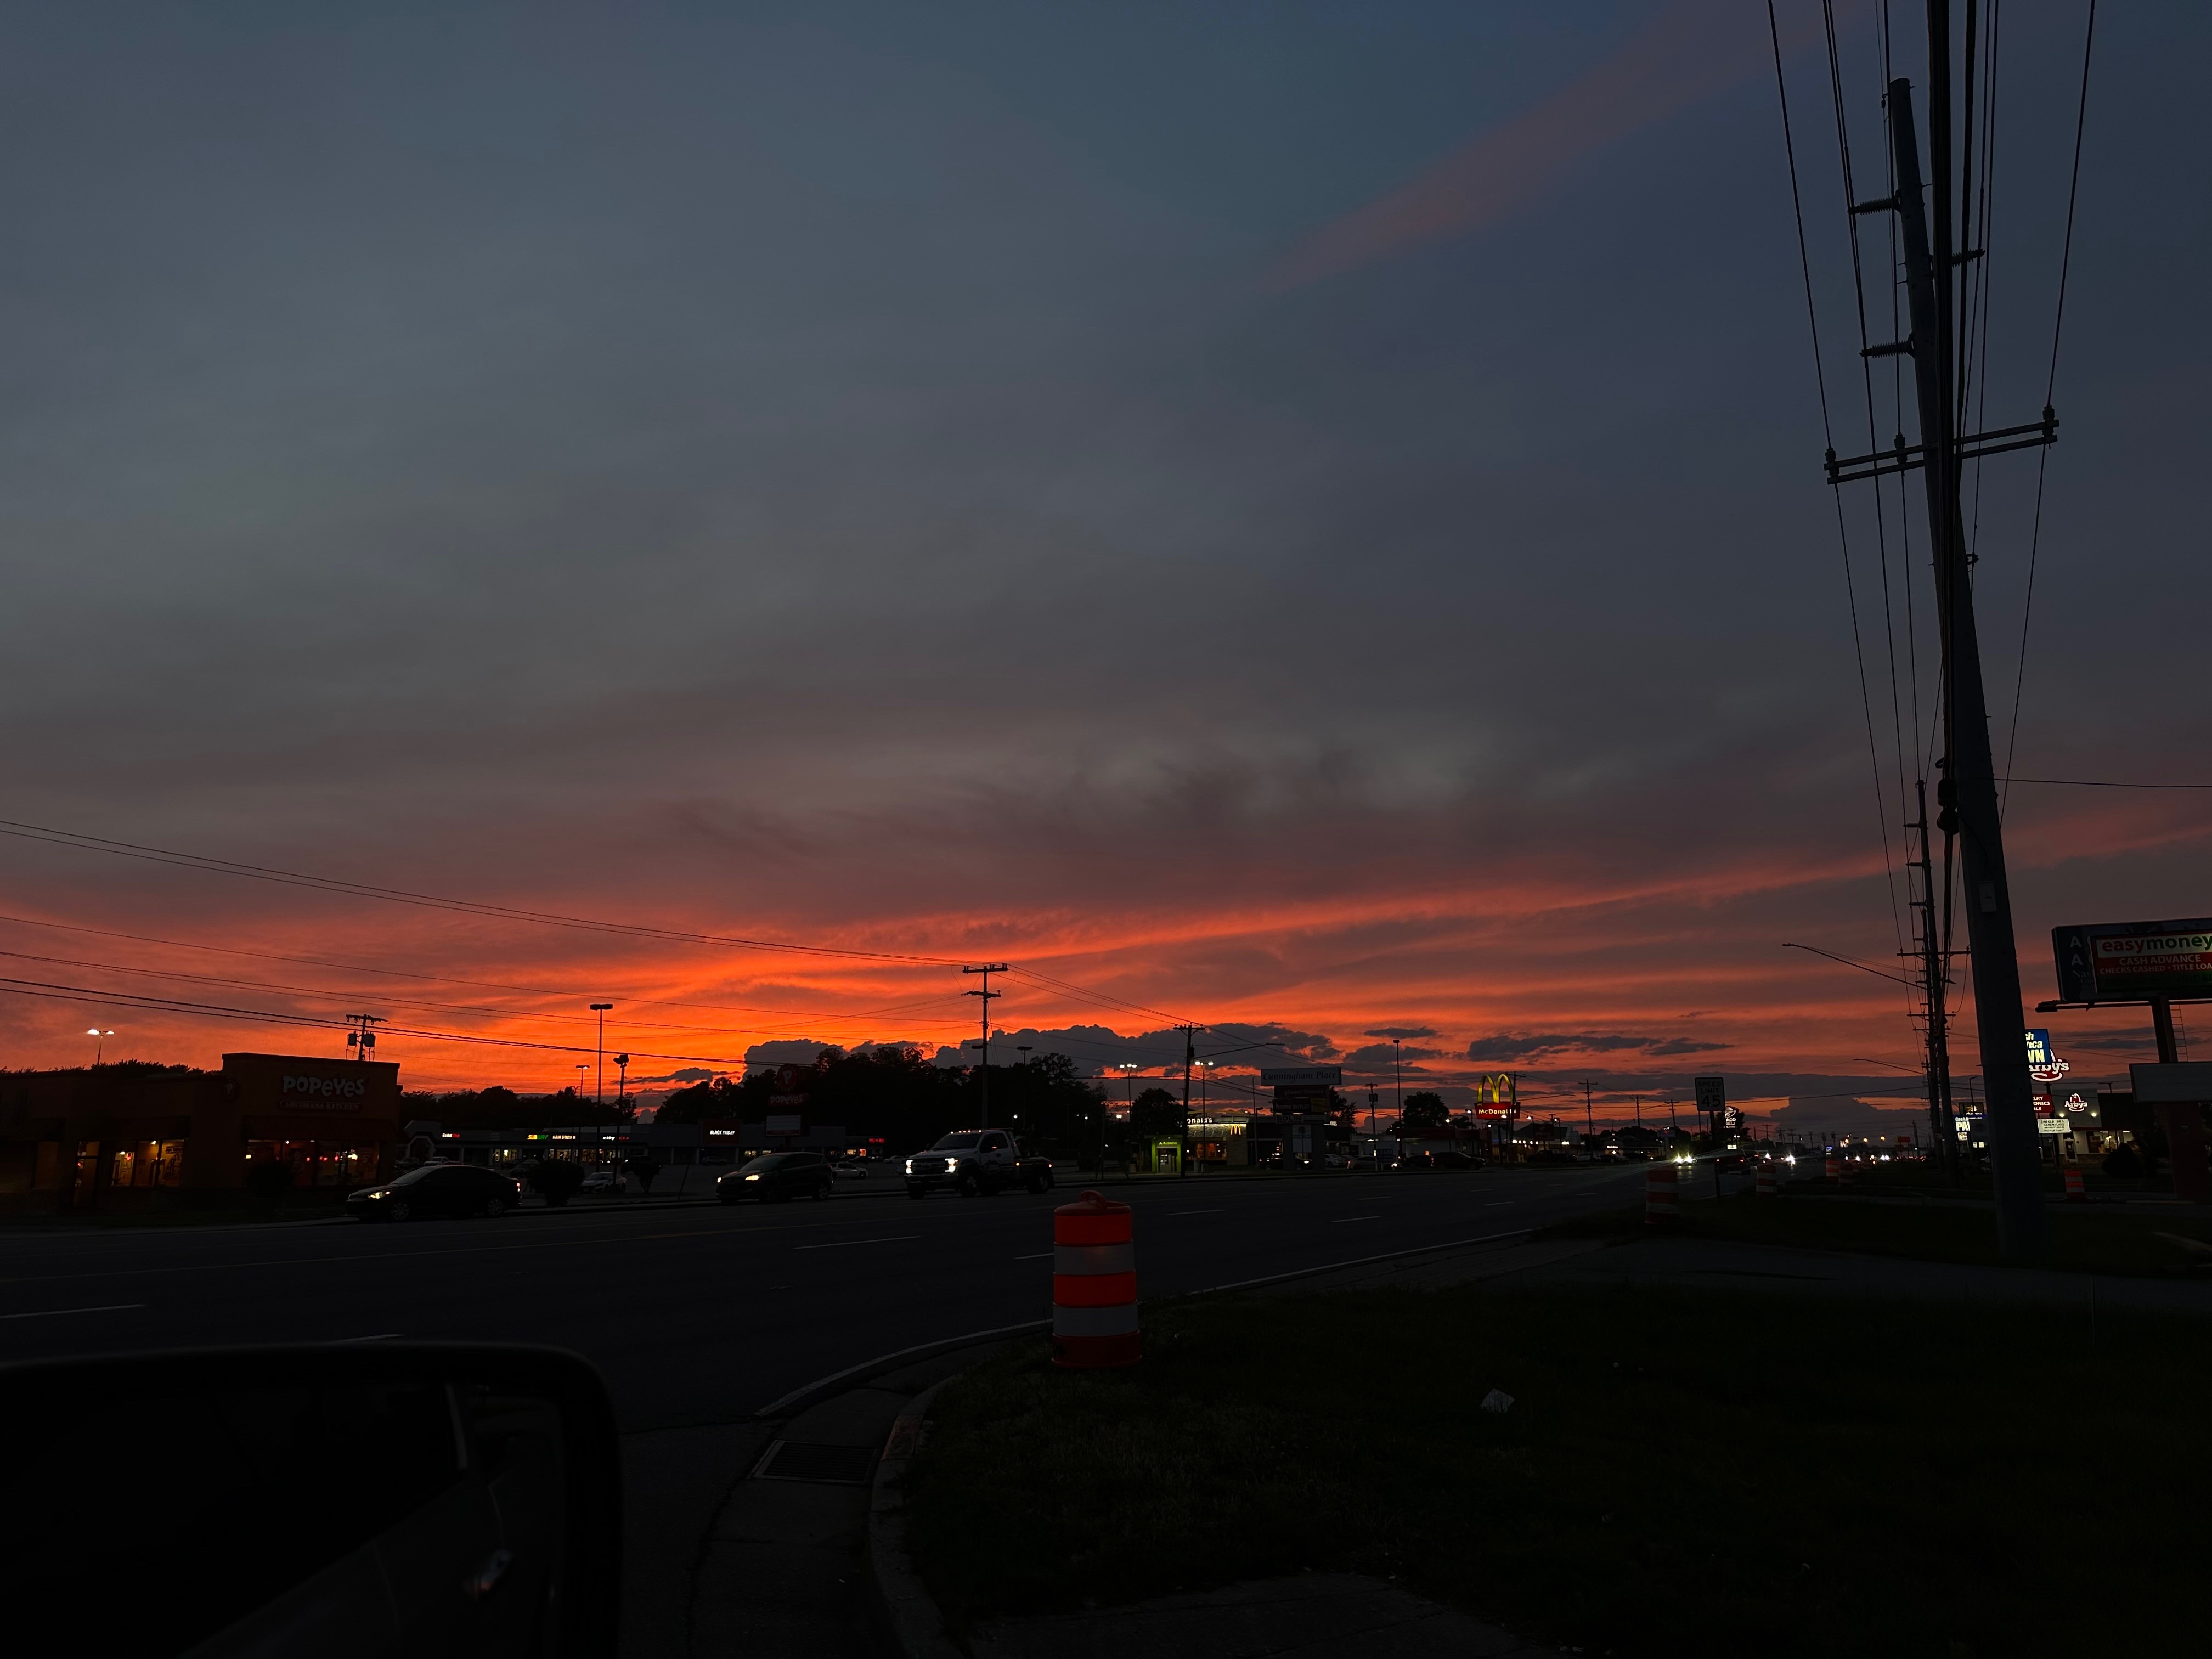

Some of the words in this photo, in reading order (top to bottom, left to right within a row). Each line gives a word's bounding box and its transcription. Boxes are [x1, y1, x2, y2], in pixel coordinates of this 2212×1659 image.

[2102, 936, 2212, 953] easymoney
[2119, 957, 2147, 966] CASH
[2151, 954, 2202, 964] ADVANCE
[2100, 966, 2131, 974] CHECKS
[1263, 1070, 1313, 1083] Cunningham
[1317, 1069, 1336, 1079] Place
[285, 1101, 324, 1109] LOUISIANA
[326, 1102, 360, 1110] KITCHEN
[1701, 1094, 1721, 1107] 45
